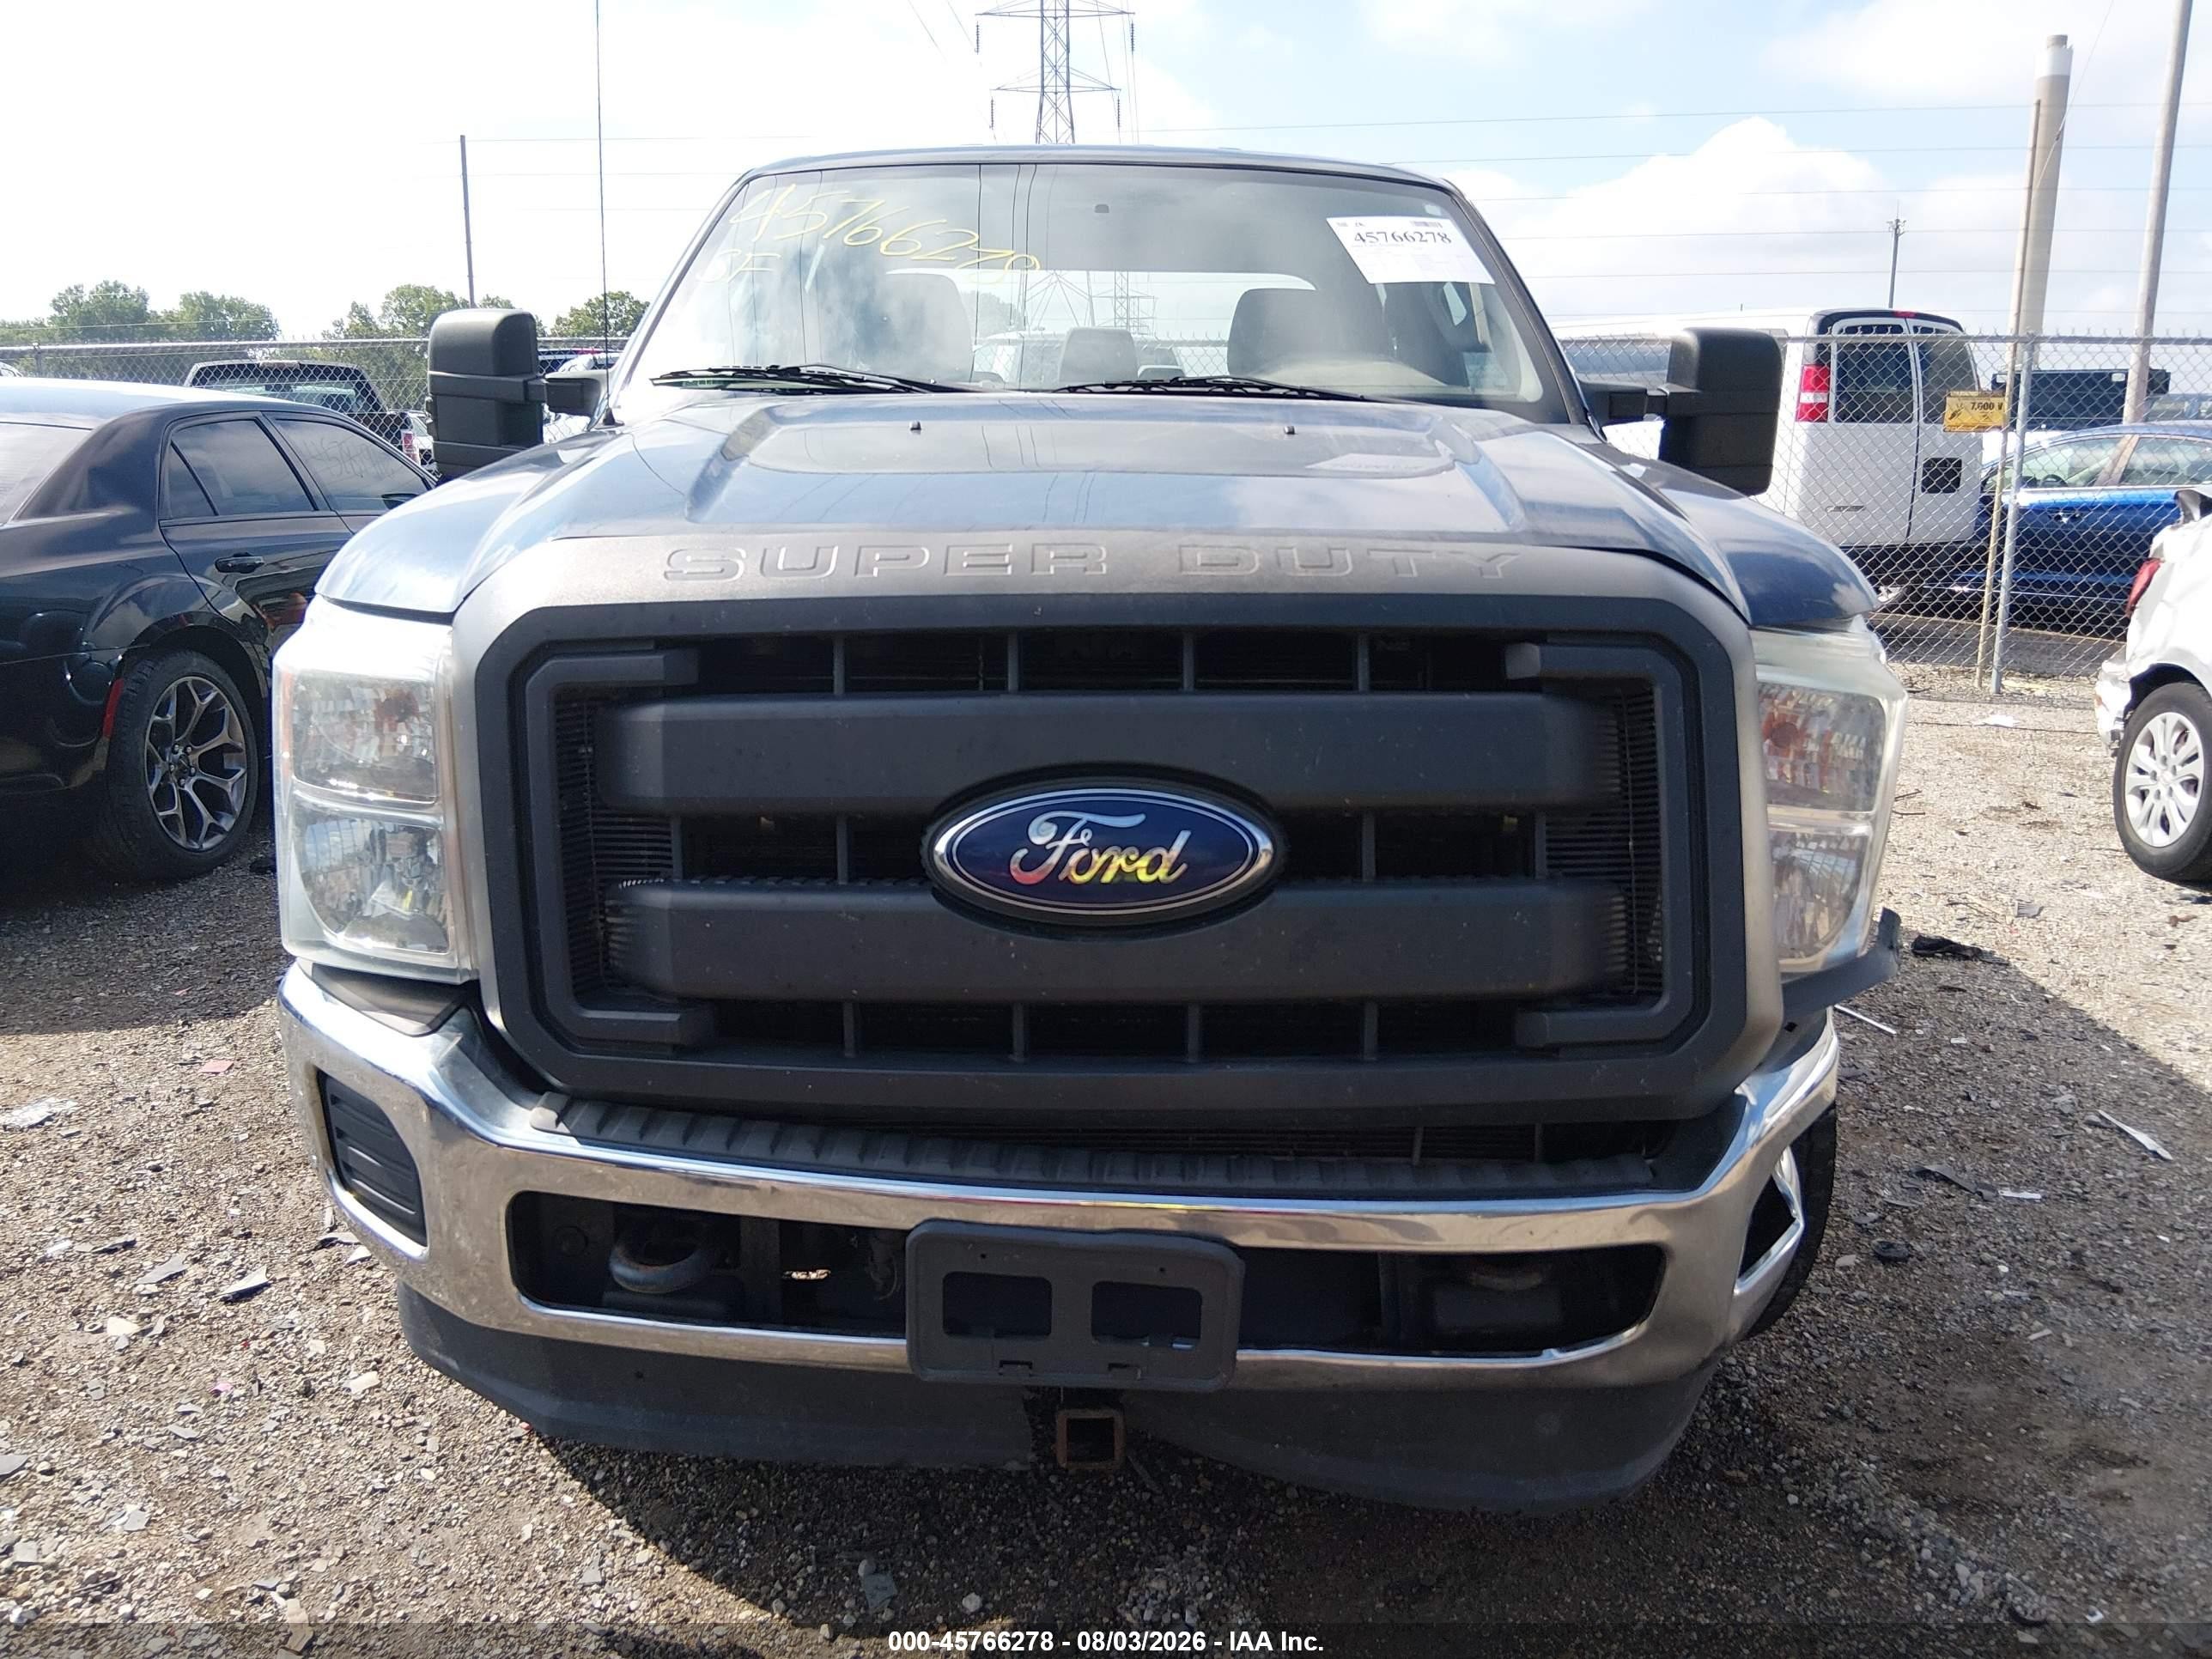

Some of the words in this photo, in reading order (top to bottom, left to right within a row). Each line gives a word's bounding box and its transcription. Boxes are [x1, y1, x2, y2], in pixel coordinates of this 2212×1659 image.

[1354, 231, 1452, 244] 45766278
[664, 544, 1107, 583] SUPER
[1179, 544, 1521, 578] DUTY
[1009, 810, 1191, 885] Ford
